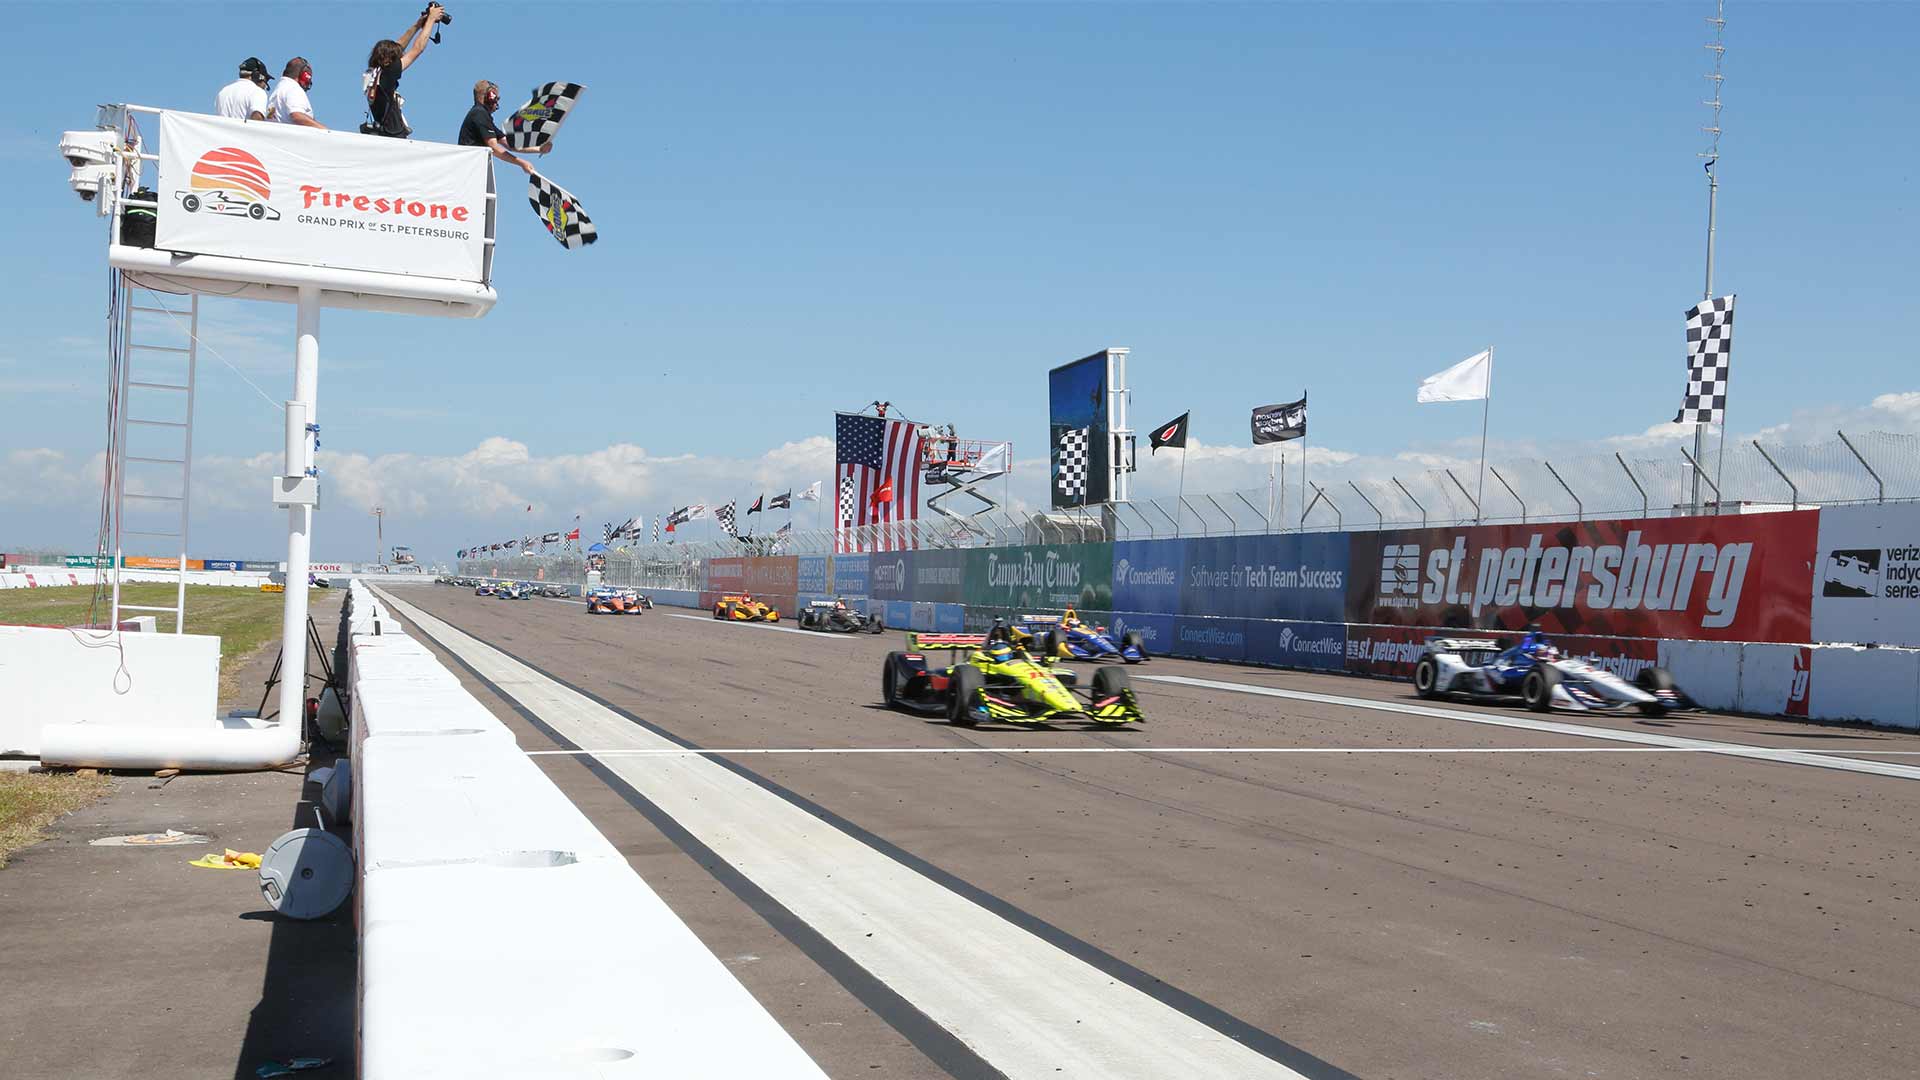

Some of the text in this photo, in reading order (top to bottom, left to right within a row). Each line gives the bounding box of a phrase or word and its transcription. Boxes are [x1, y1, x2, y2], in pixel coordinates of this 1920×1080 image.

[299, 185, 469, 222] Firestone
[297, 214, 337, 227] GRAND
[339, 219, 366, 230] PRIX
[379, 223, 395, 233] ST.
[397, 225, 470, 241] PETERSBURG
[988, 553, 1021, 598] Tampa
[1022, 552, 1044, 593] Bay
[1046, 550, 1081, 588] Times
[1129, 567, 1175, 585] ConnectWise
[1191, 564, 1342, 589] Software for Tech Team Success
[1885, 582, 1920, 598] serie
[1123, 624, 1157, 640] CectWise
[1180, 625, 1243, 645] ConnectWise.com
[1293, 637, 1342, 656] ConnectWise
[1359, 637, 1425, 664] st.petersbur
